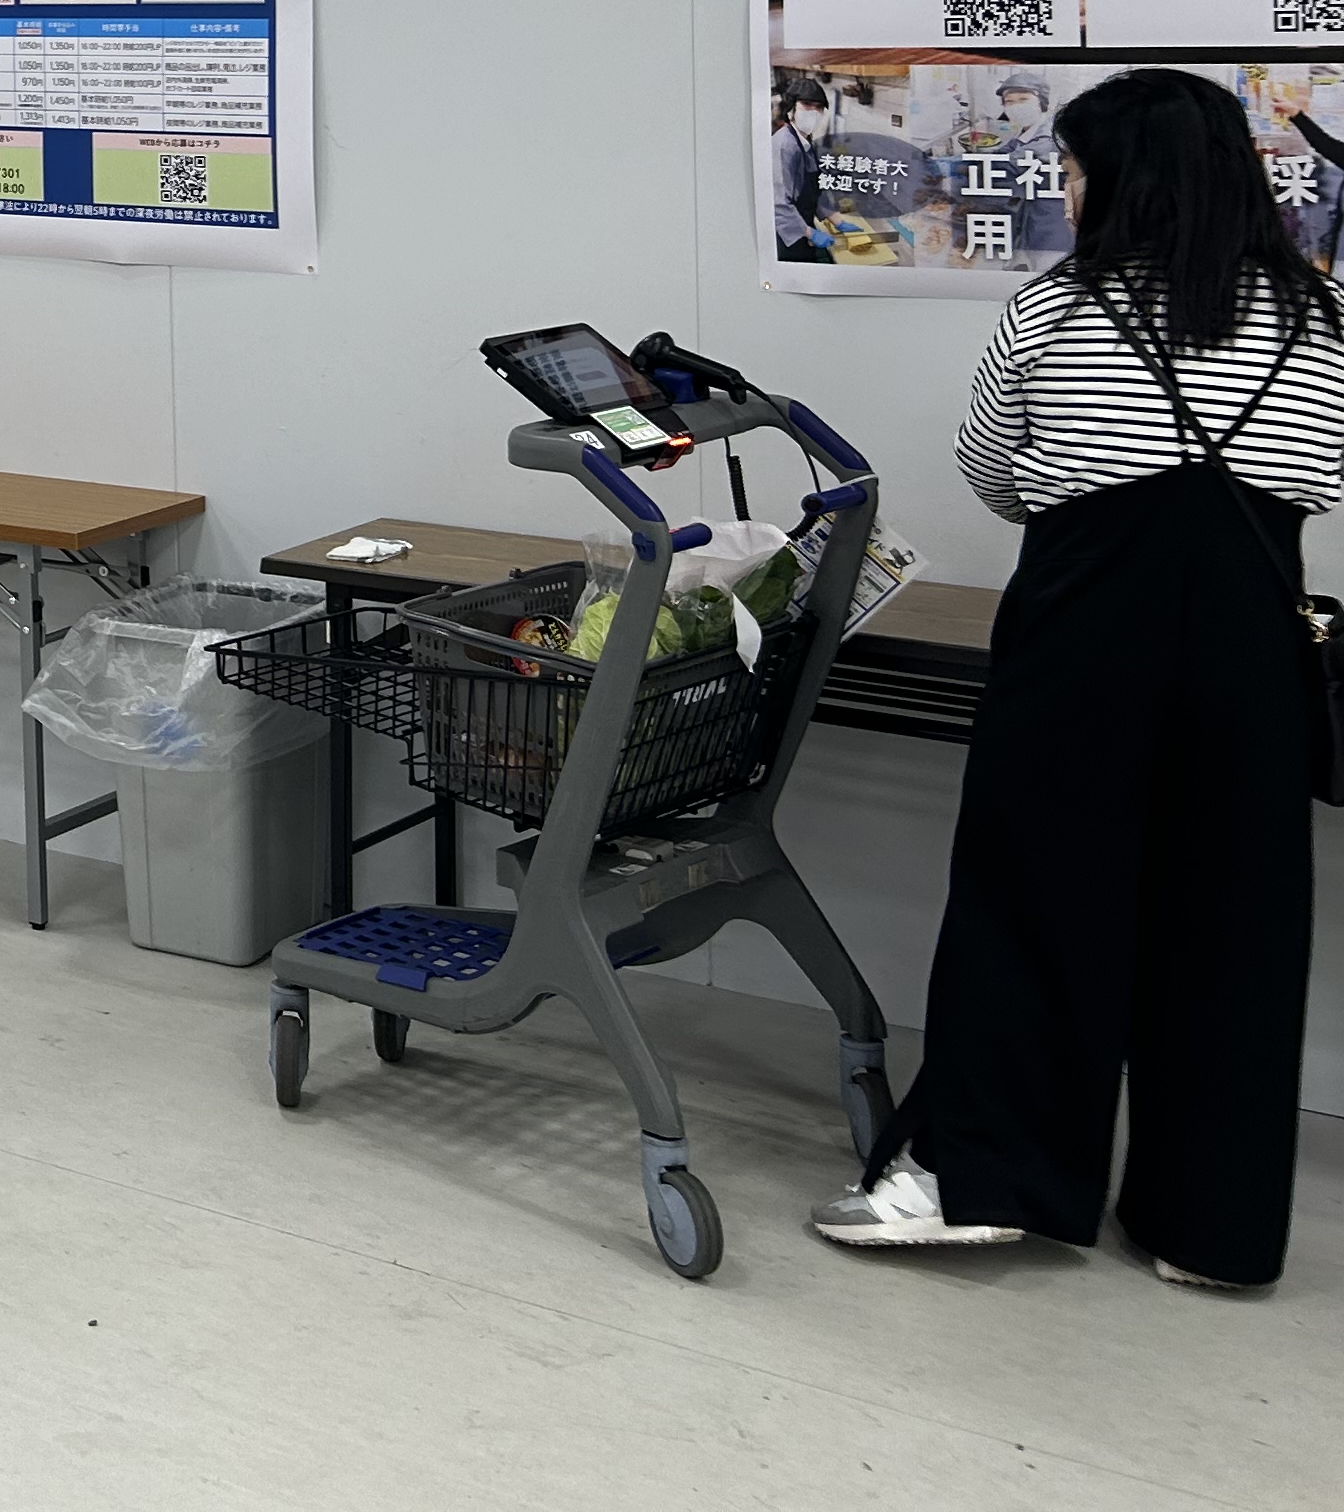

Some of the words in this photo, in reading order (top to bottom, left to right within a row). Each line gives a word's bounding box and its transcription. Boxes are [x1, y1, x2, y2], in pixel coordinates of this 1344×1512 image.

[819, 153, 908, 178] 未経験者大
[818, 172, 900, 196] 歓迎です！
[963, 214, 1012, 259] 用
